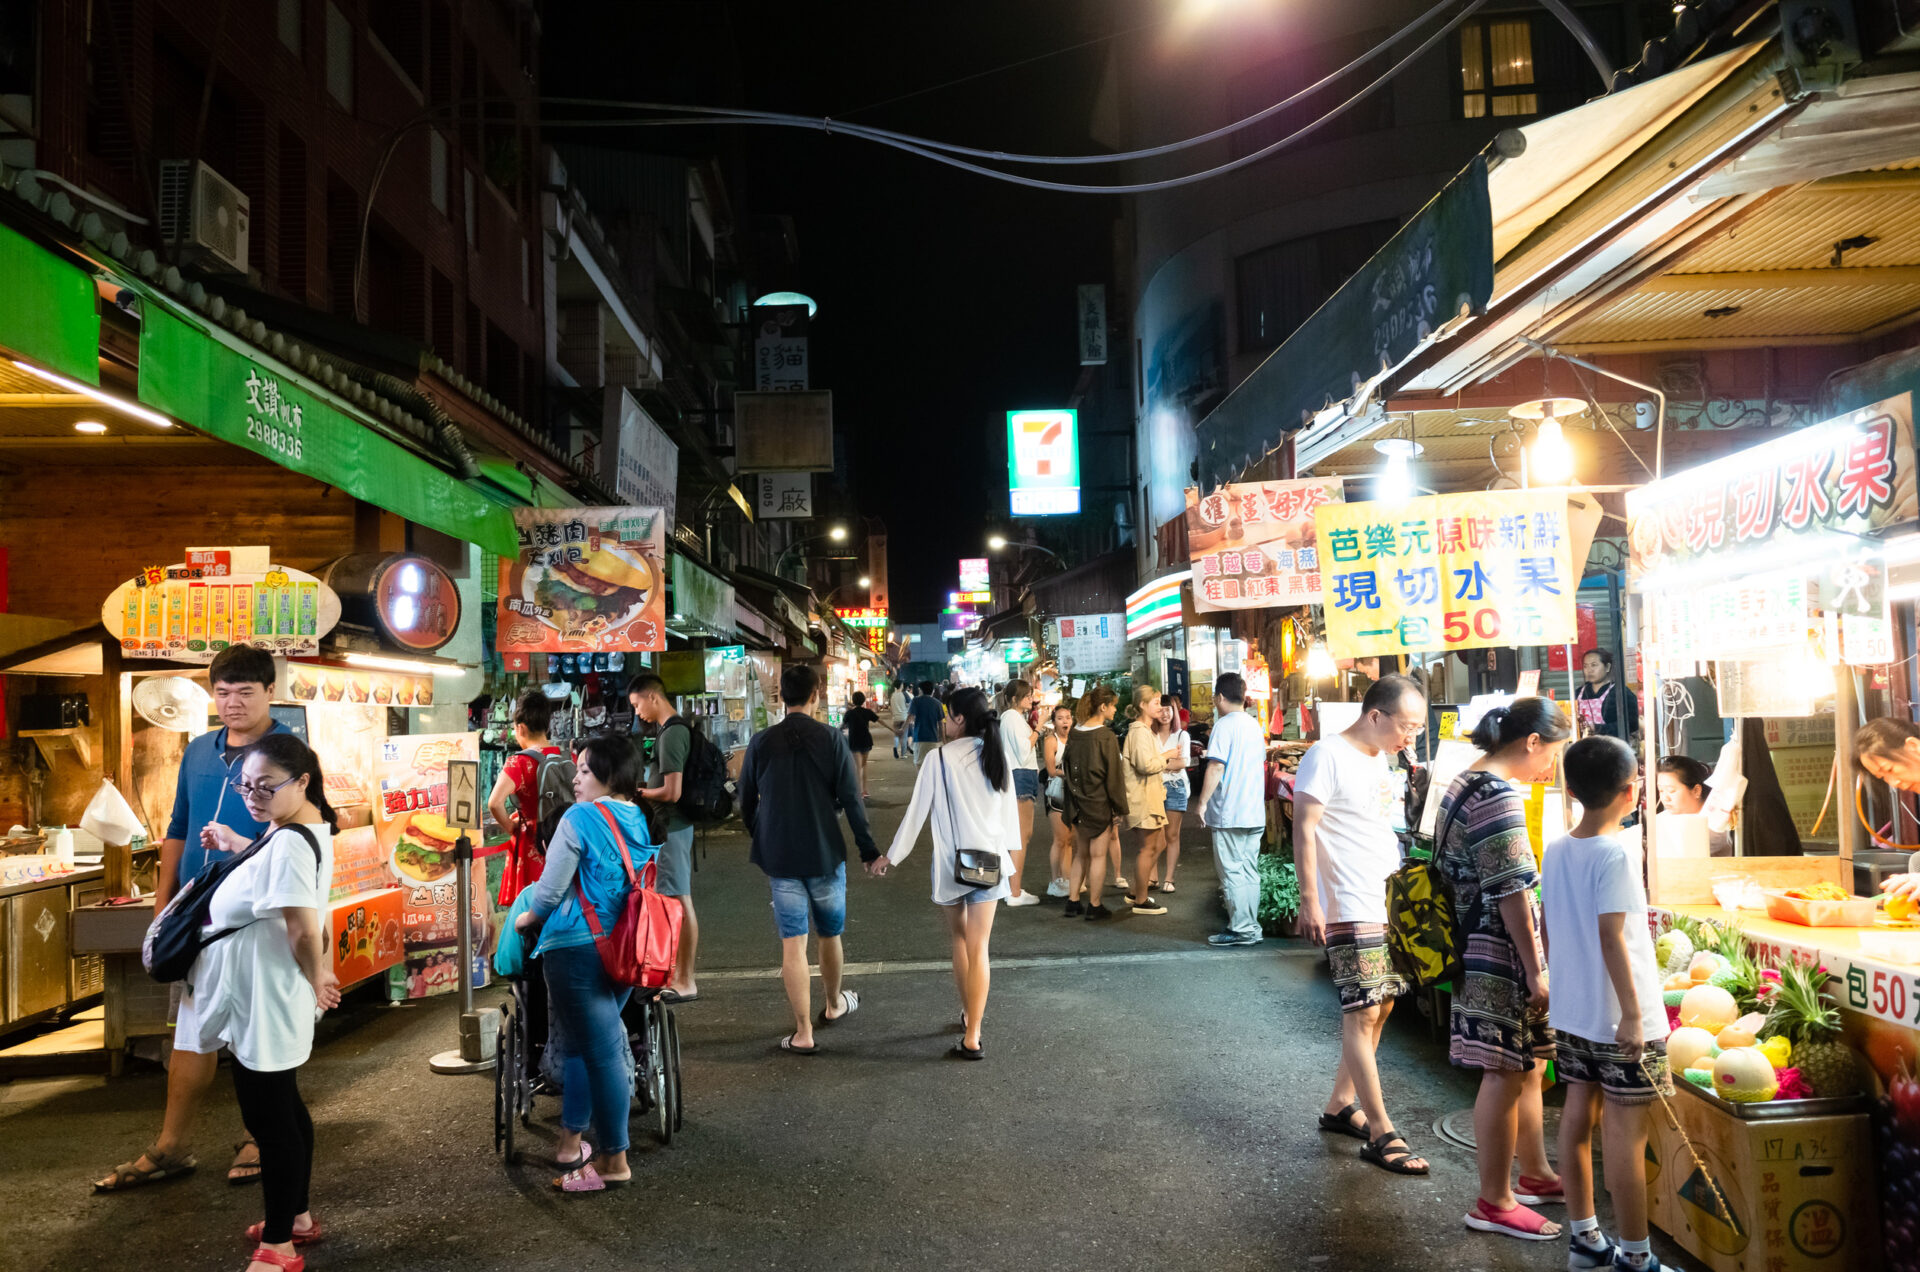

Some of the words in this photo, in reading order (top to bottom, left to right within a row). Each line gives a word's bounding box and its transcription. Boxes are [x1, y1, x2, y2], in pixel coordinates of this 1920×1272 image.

[760, 347, 770, 370] Owl
[247, 416, 302, 460] 2988336
[762, 478, 774, 507] 2005
[1686, 413, 1895, 551] 現切水果
[190, 551, 217, 564] 南瓜
[528, 546, 583, 567] 大刈包
[1202, 551, 1263, 577] 蔓越莓
[202, 563, 229, 577] 外皮
[1205, 579, 1239, 601] 桂圓
[1245, 576, 1280, 599] 紅棗
[1287, 573, 1322, 594] 黑糖
[1333, 556, 1562, 612] 現切水果
[509, 599, 550, 617] 南瓜外皮
[457, 766, 474, 823] 入口
[403, 912, 432, 926] 瓜外皮
[1764, 1138, 1784, 1159] 17
[1794, 1143, 1804, 1160] A
